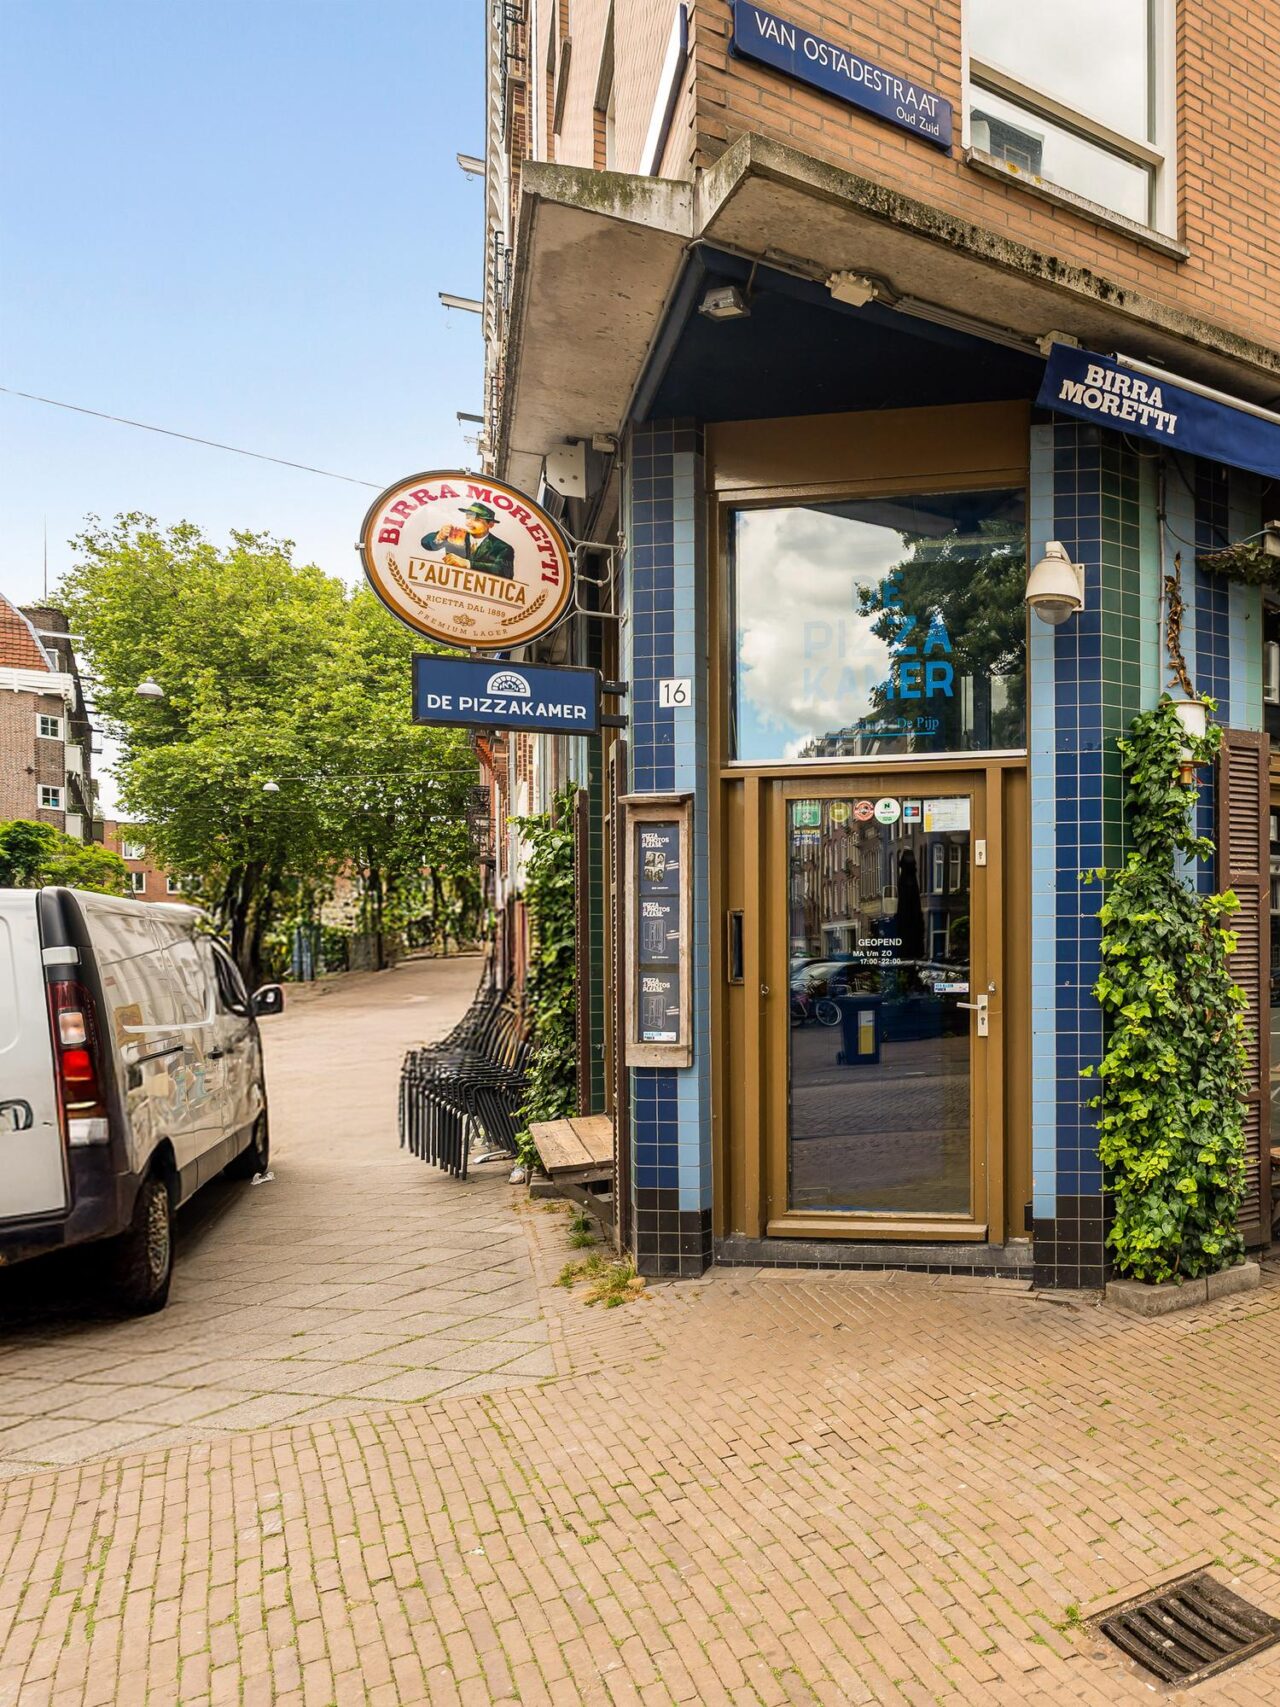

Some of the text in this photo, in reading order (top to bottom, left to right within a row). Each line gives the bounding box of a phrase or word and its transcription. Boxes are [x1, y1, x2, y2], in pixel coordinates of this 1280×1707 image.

[754, 11, 939, 117] VAN OSTADESTRAAT
[896, 106, 939, 136] Oud Zuid
[1084, 364, 1163, 408] BIRRA
[1059, 379, 1178, 435] MORETTI
[377, 484, 560, 586] BIRRA MORETTI
[408, 560, 527, 605] L'AUTENTICA
[425, 594, 465, 609] RICETTA
[466, 603, 485, 613] DAL
[417, 610, 508, 637] PREMIUM LAGER
[427, 694, 587, 720] DE PIZZAKAMER
[664, 683, 686, 704] 16
[896, 717, 913, 729] De
[917, 716, 939, 731] Pijp
[858, 938, 903, 947] GEOPEND
